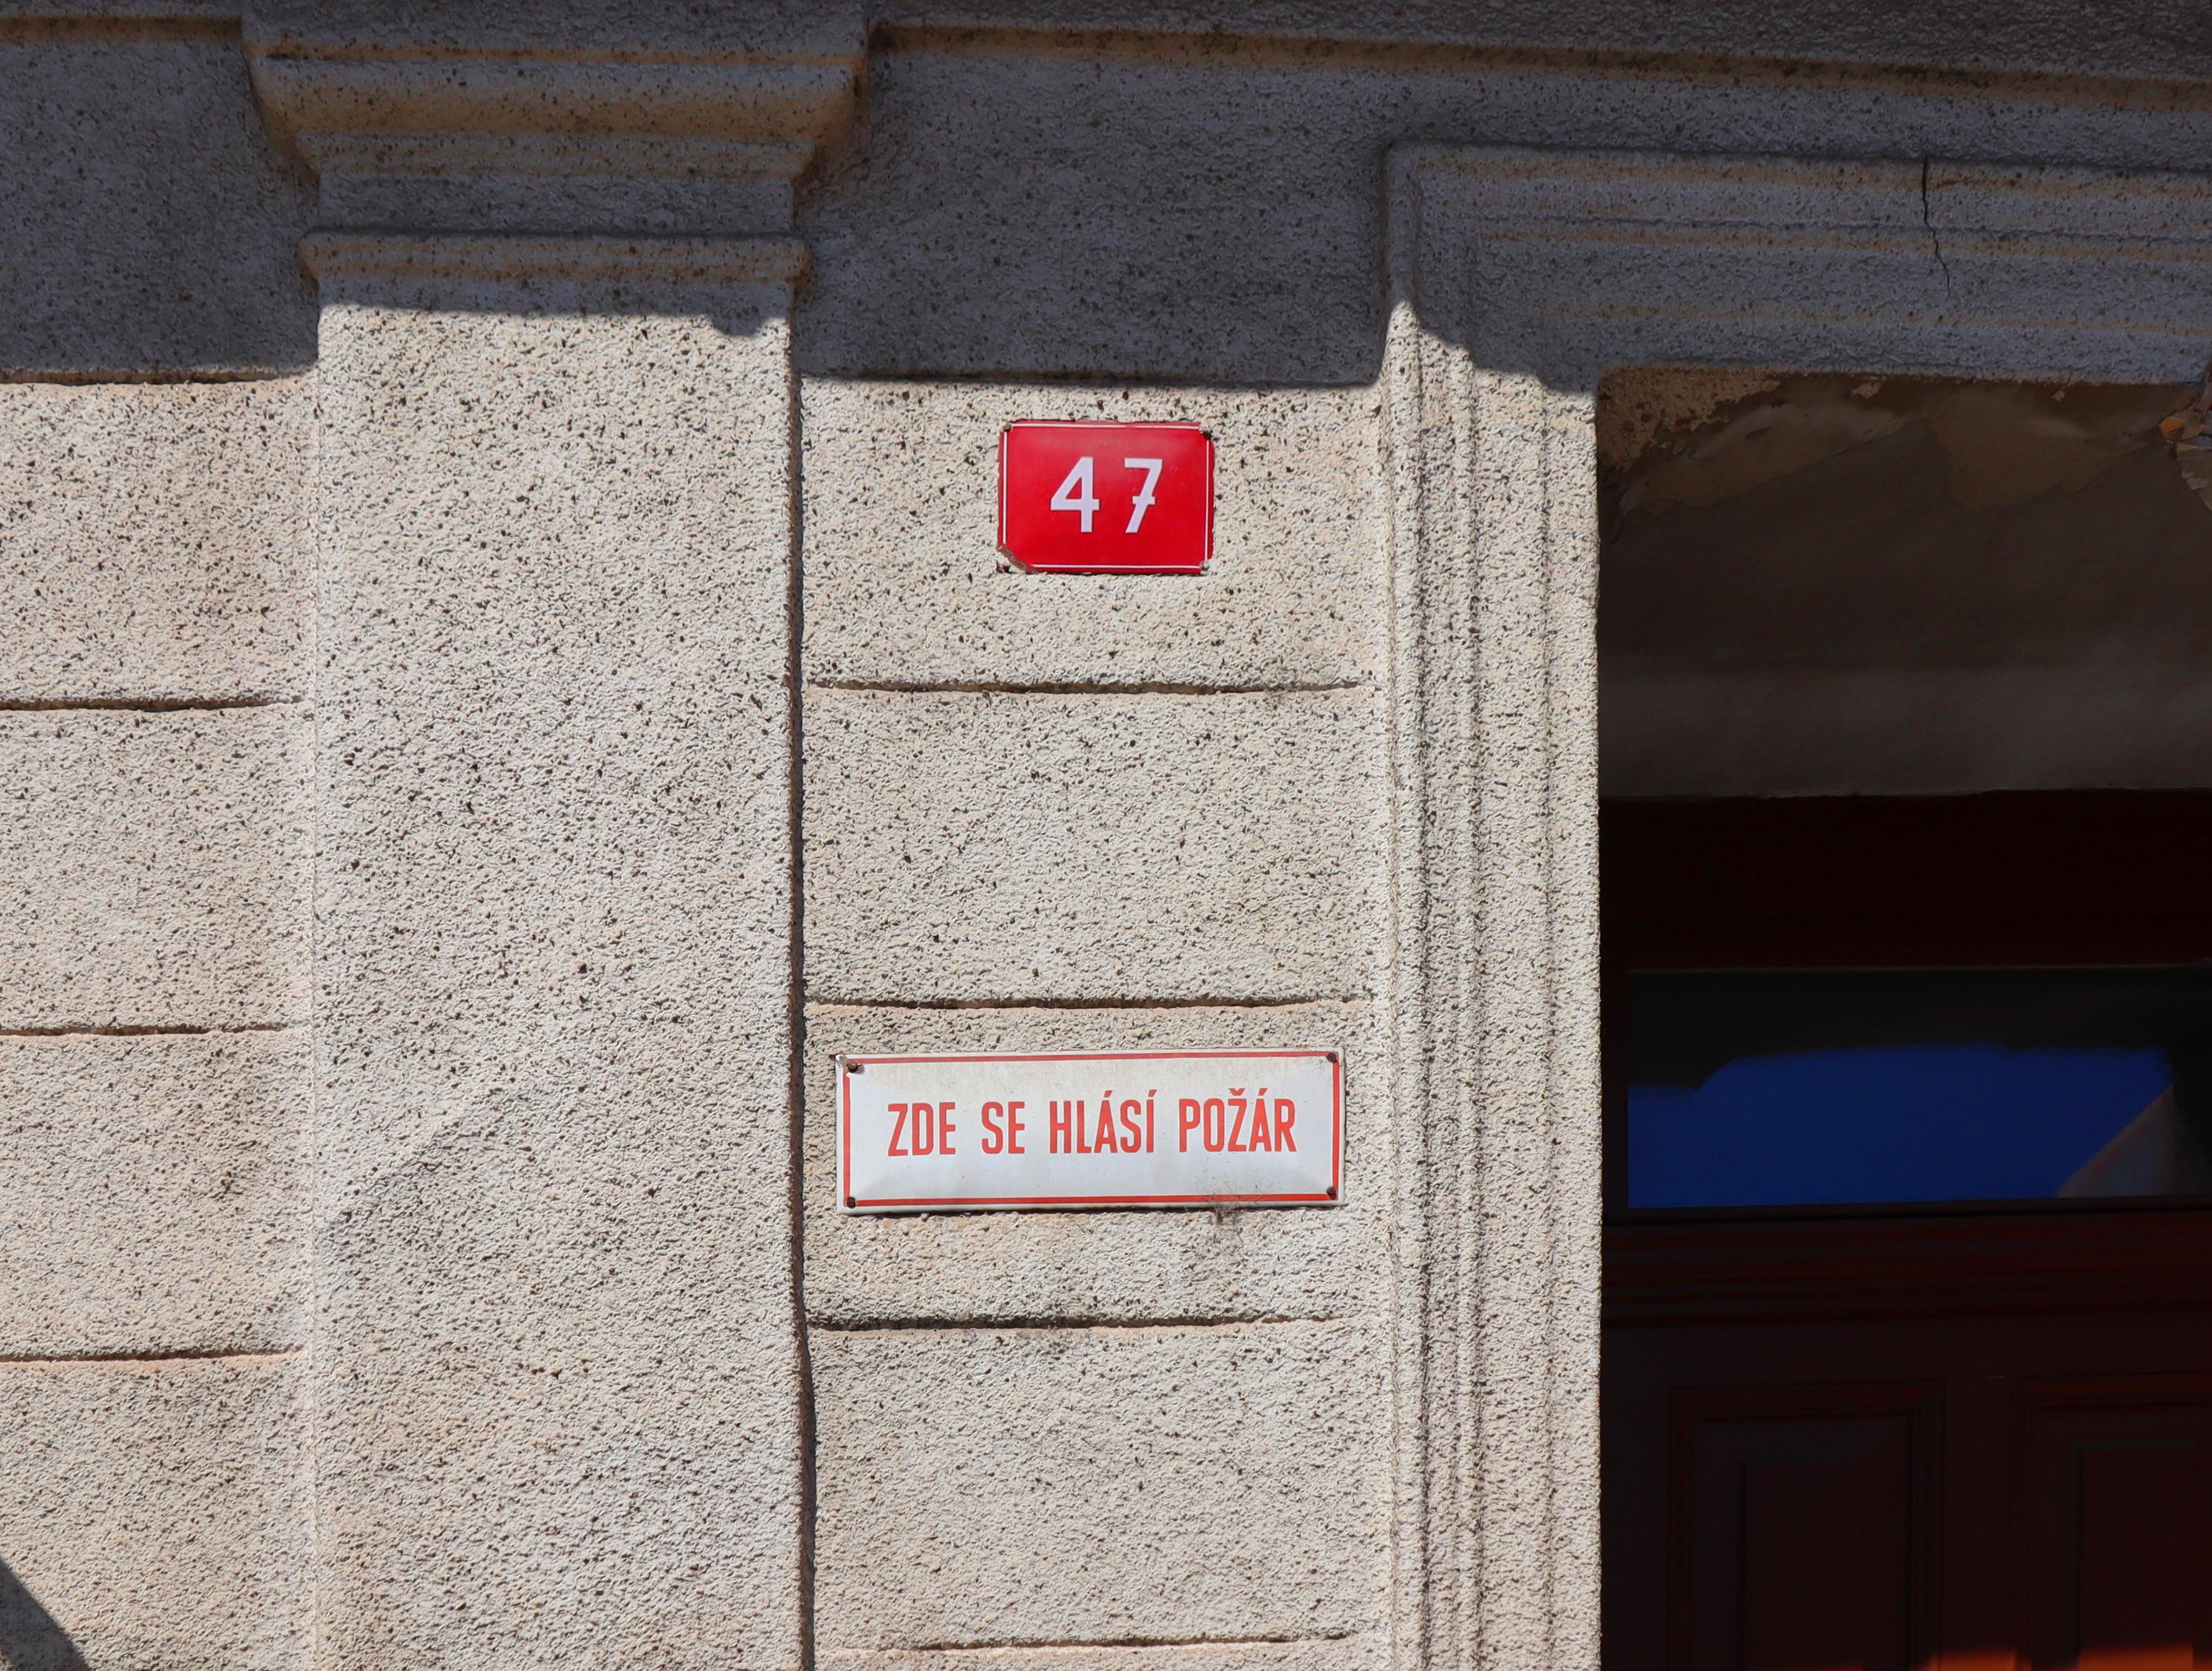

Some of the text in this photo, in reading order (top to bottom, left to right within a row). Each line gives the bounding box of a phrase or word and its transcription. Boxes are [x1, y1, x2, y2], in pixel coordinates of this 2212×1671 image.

[1051, 456, 1163, 533] 47
[888, 1087, 1297, 1157] ZDE SE HLÁSÍ POŽÁR
